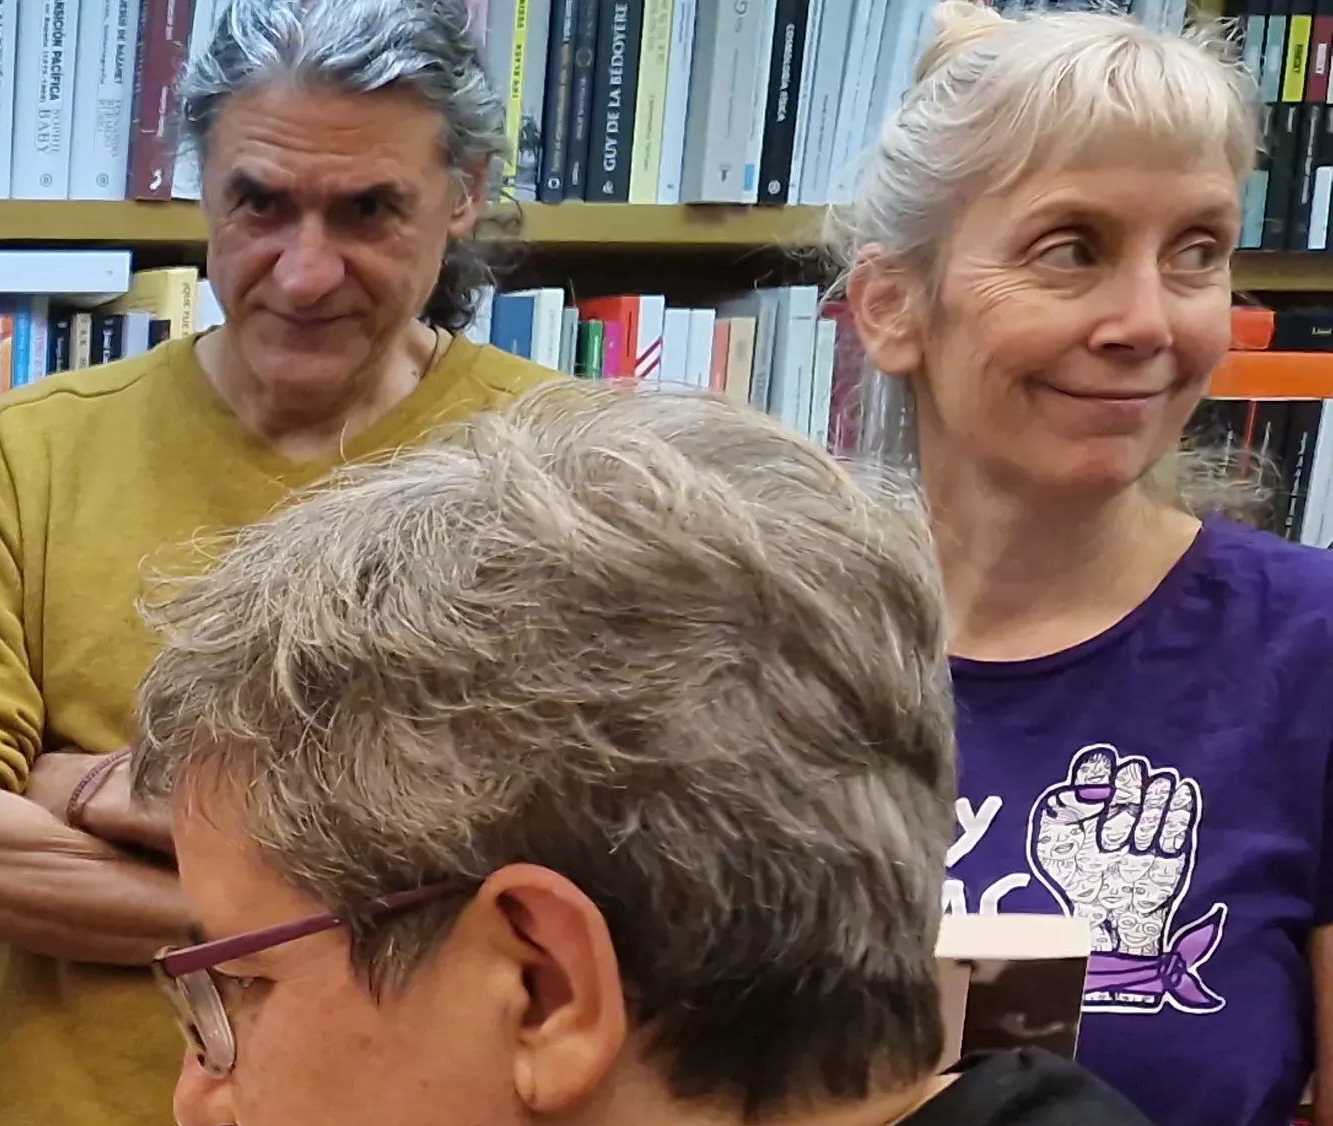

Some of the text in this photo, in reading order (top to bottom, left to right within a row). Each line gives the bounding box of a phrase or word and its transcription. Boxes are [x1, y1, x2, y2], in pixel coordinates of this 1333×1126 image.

[48, 50, 65, 101] PACÍFICA
[602, 2, 629, 172] GUY DE LA BÉDOYÈRE
[35, 109, 52, 155] BABY
